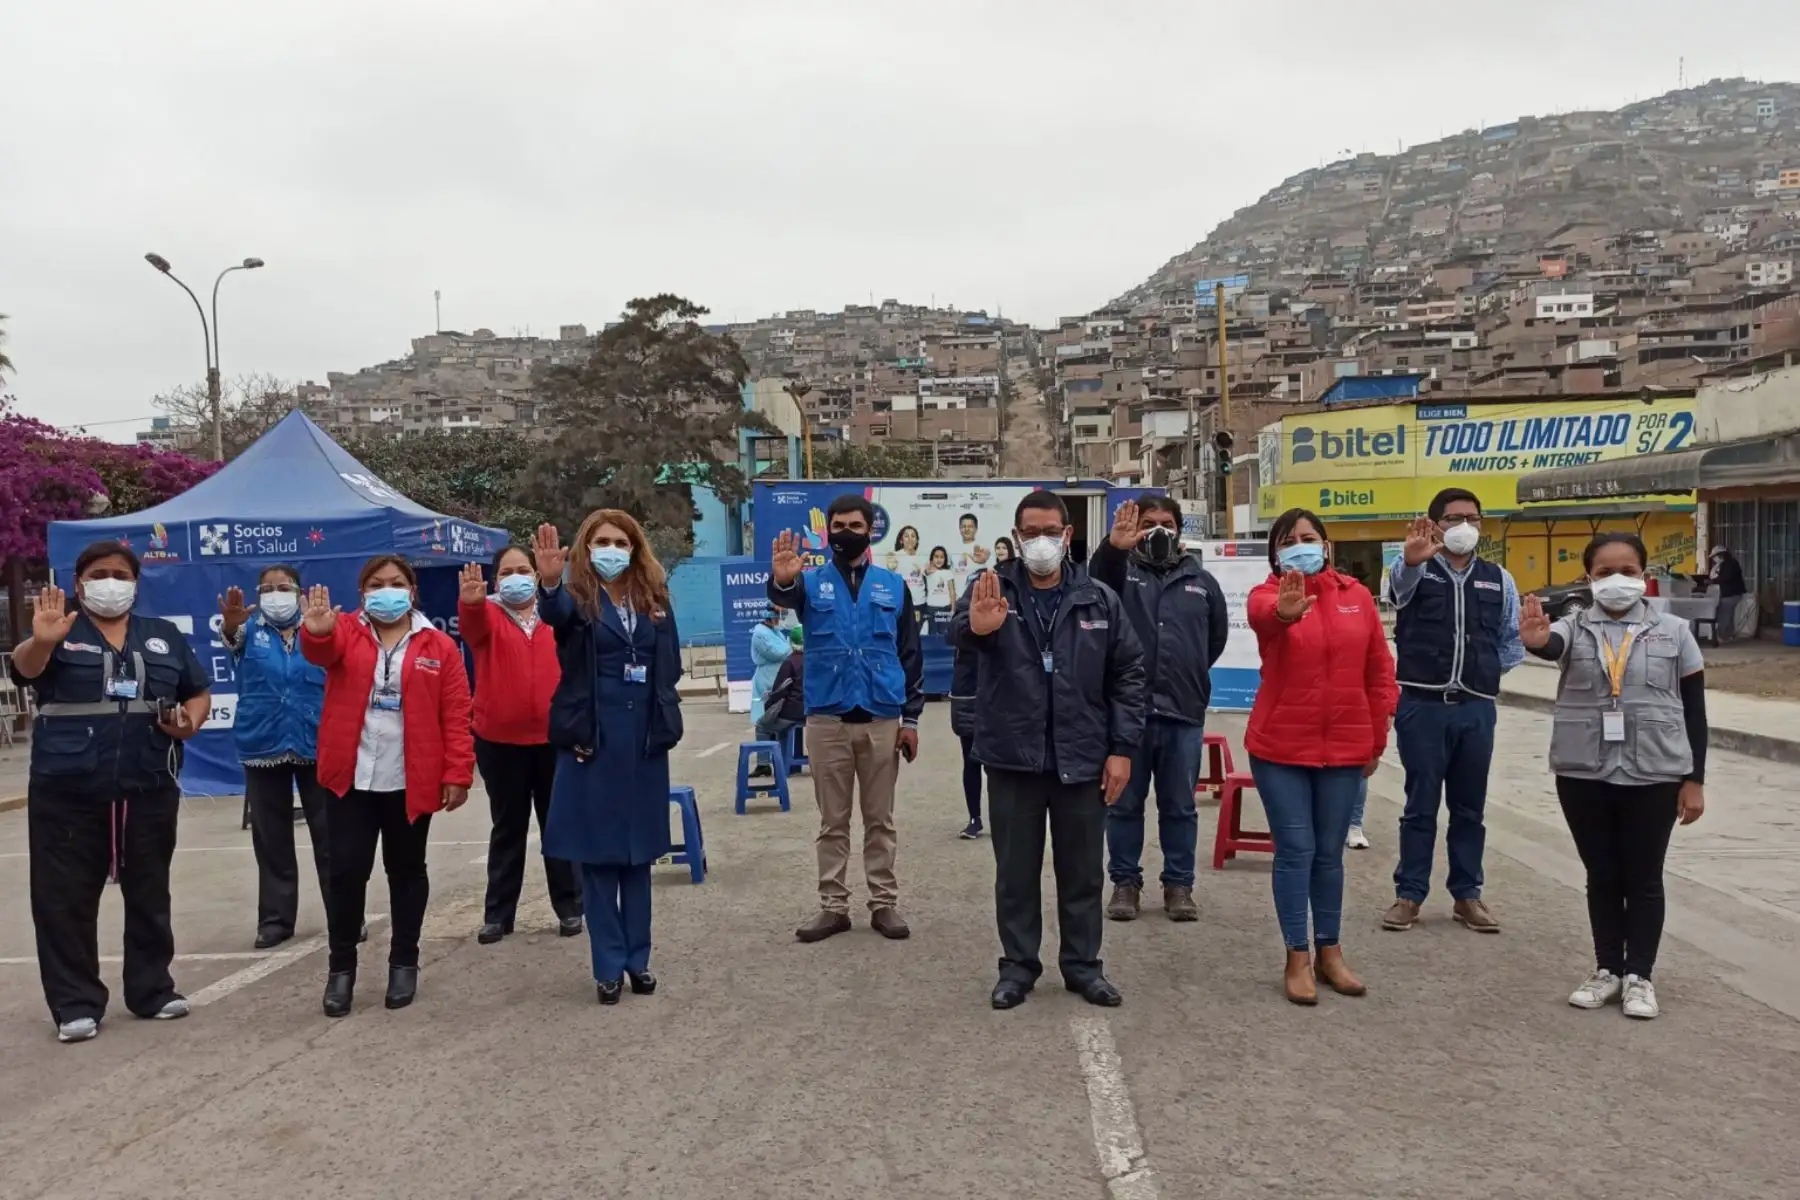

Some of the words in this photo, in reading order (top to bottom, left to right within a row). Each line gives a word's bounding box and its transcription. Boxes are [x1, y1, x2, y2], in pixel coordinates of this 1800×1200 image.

[1418, 409, 1442, 418] ELIGE
[1636, 412, 1667, 431] POR
[1424, 420, 1494, 457] TODO
[1496, 412, 1632, 452] ILIMITADO
[1665, 411, 1697, 451] 2
[1321, 424, 1405, 460] bitel
[1448, 455, 1517, 473] MINUTOS
[1532, 451, 1603, 468] INTERNET
[1333, 489, 1375, 506] bitel
[234, 523, 283, 538] Socios
[235, 540, 254, 554] En
[257, 538, 298, 554] Salud
[726, 572, 769, 586] MINSA
